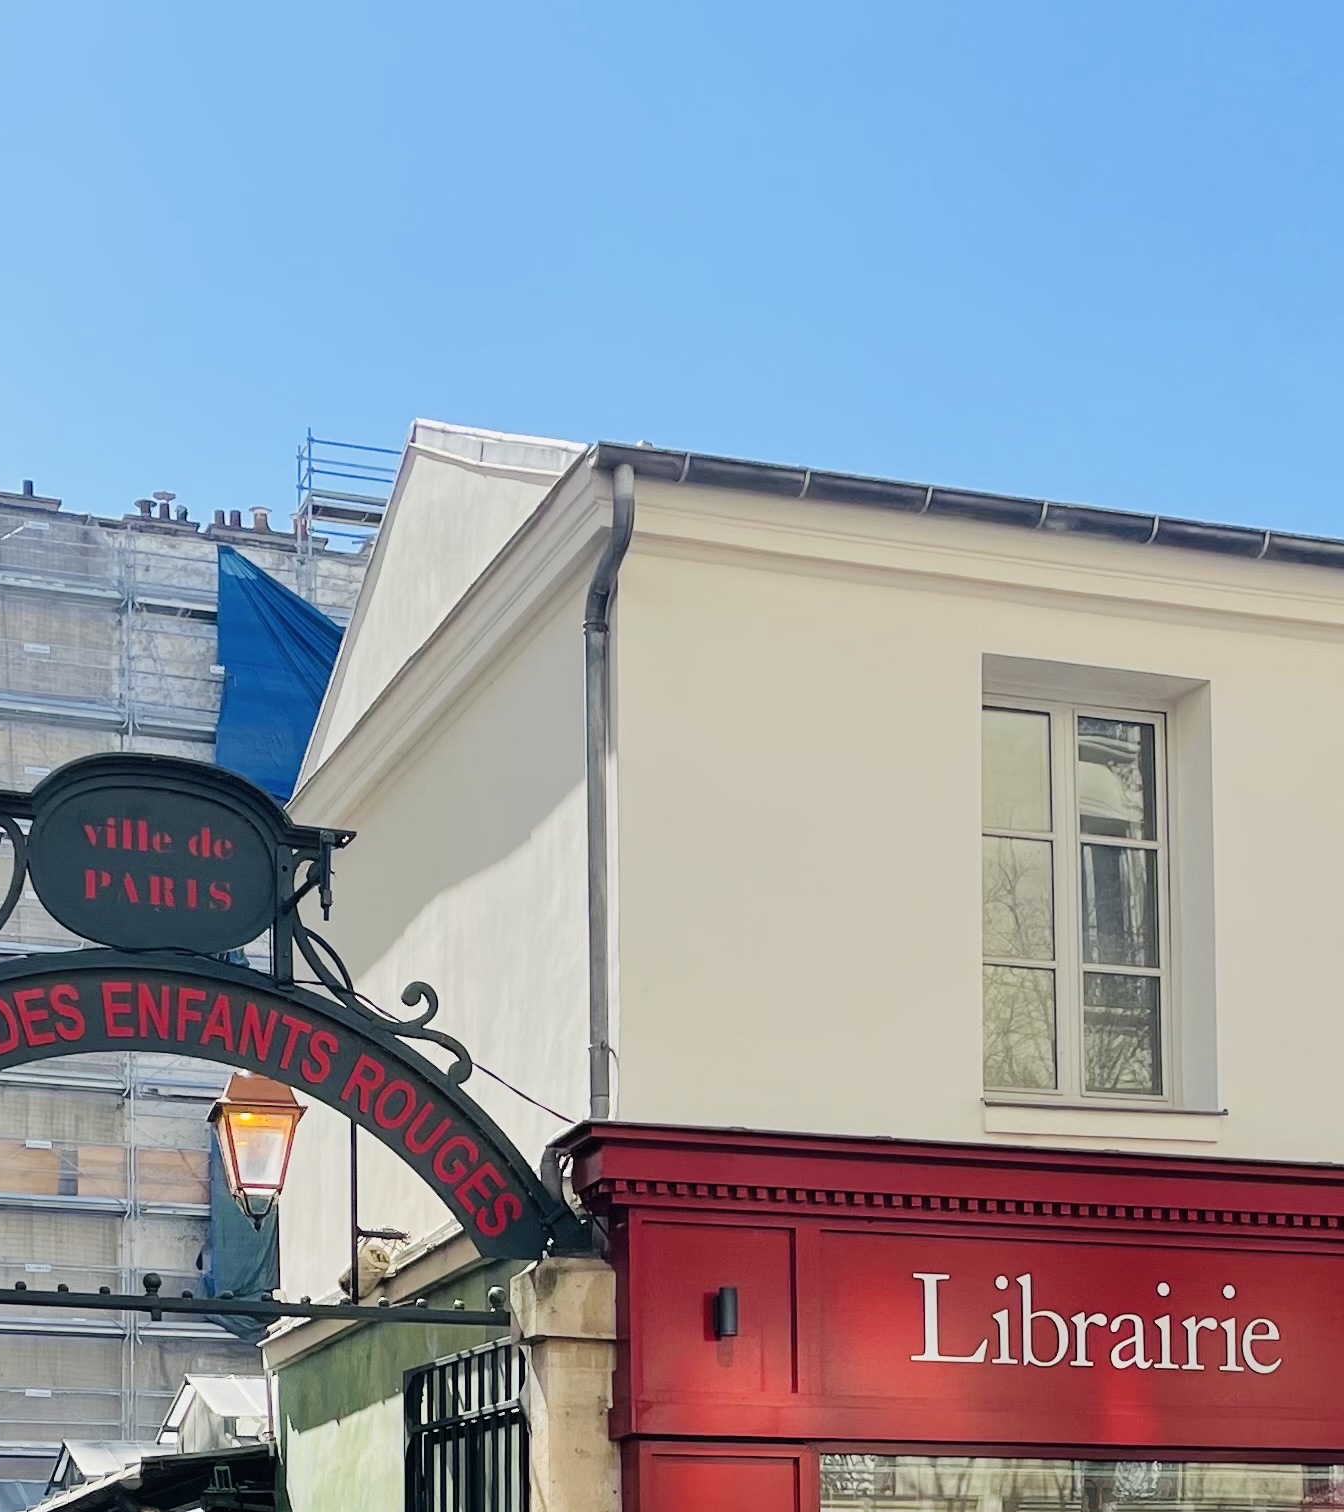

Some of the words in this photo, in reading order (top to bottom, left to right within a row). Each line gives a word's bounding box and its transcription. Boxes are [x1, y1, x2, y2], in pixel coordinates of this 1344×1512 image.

[83, 815, 174, 854] ville
[187, 826, 235, 860] de
[84, 867, 234, 912] PARIS
[100, 980, 339, 1084] ENFANTS
[340, 1052, 524, 1239] ROUGES
[909, 1271, 1283, 1375] Librairie
